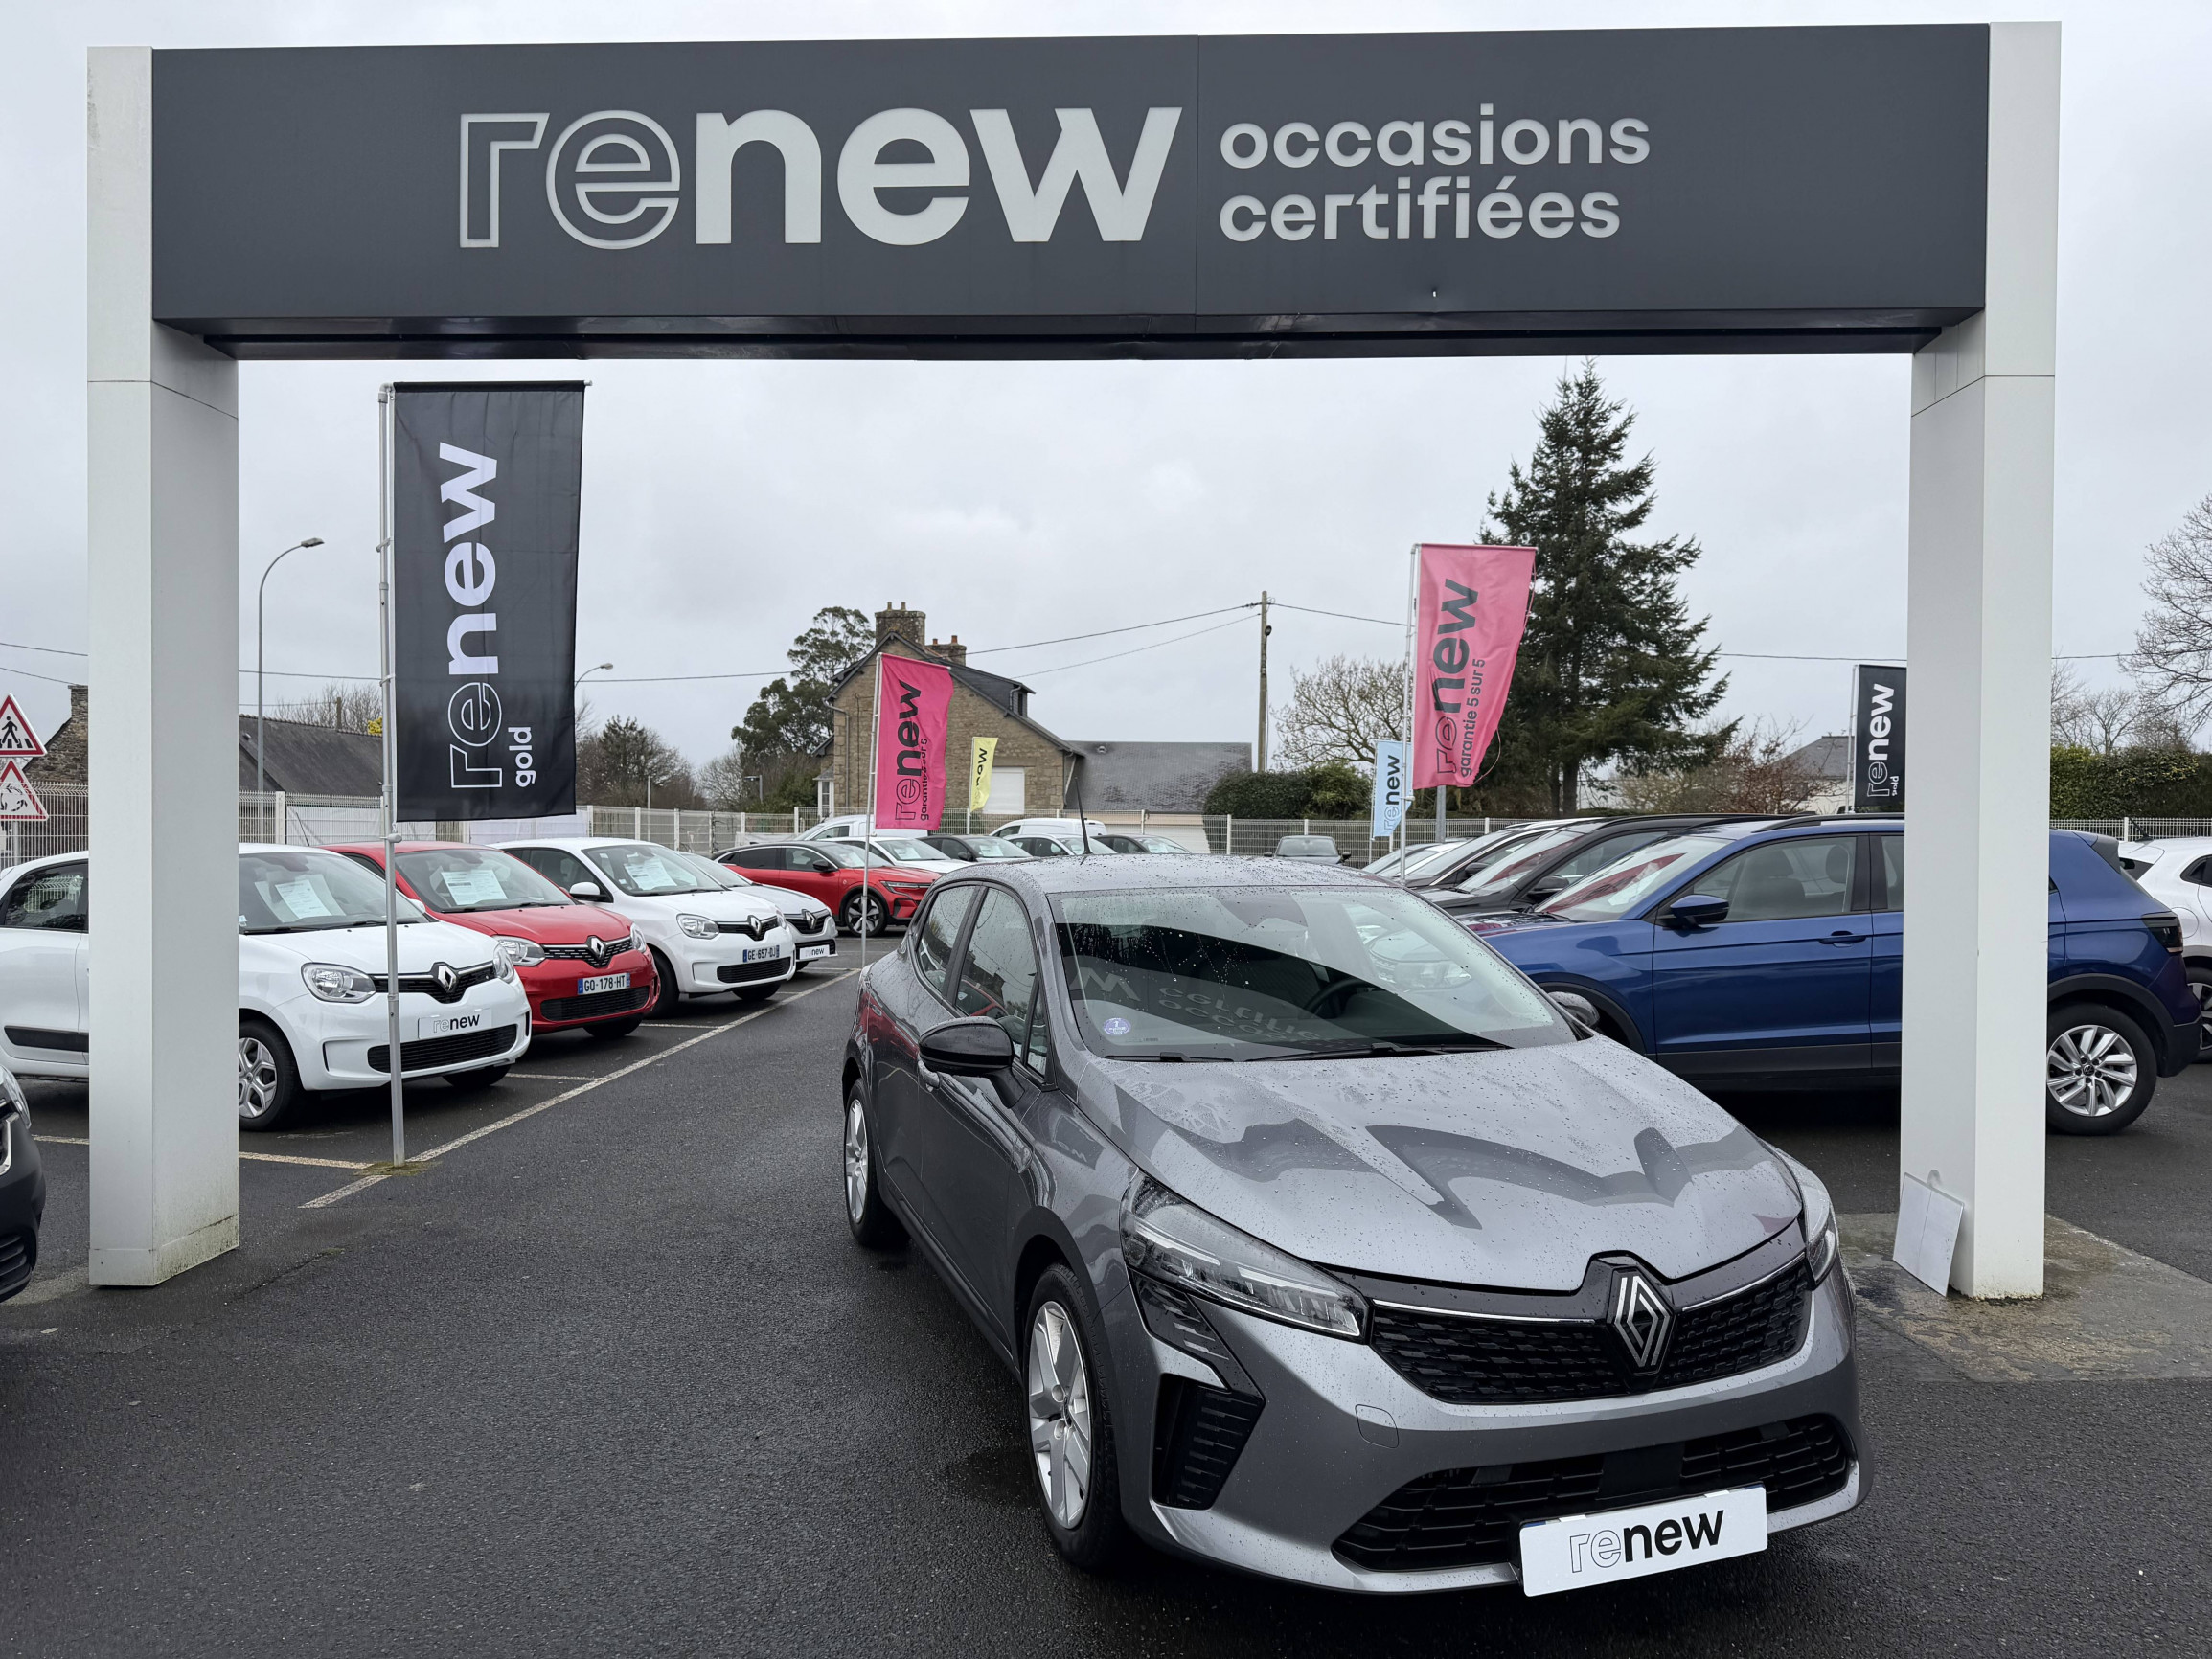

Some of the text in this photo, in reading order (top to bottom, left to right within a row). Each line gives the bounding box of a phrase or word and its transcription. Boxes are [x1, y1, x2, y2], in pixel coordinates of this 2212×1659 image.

[460, 106, 1183, 250] renew
[1220, 102, 1651, 169] occasions
[1219, 175, 1621, 242] certifiées
[439, 442, 503, 788] renew
[1432, 578, 1479, 775] renew
[1460, 658, 1486, 778] garantie 5 sur 5
[508, 726, 536, 788] gold
[895, 679, 922, 821] renew
[1866, 683, 1895, 798] renew
[1384, 754, 1401, 830] renew
[433, 1014, 481, 1034] renew
[1569, 1509, 1724, 1574] renew
